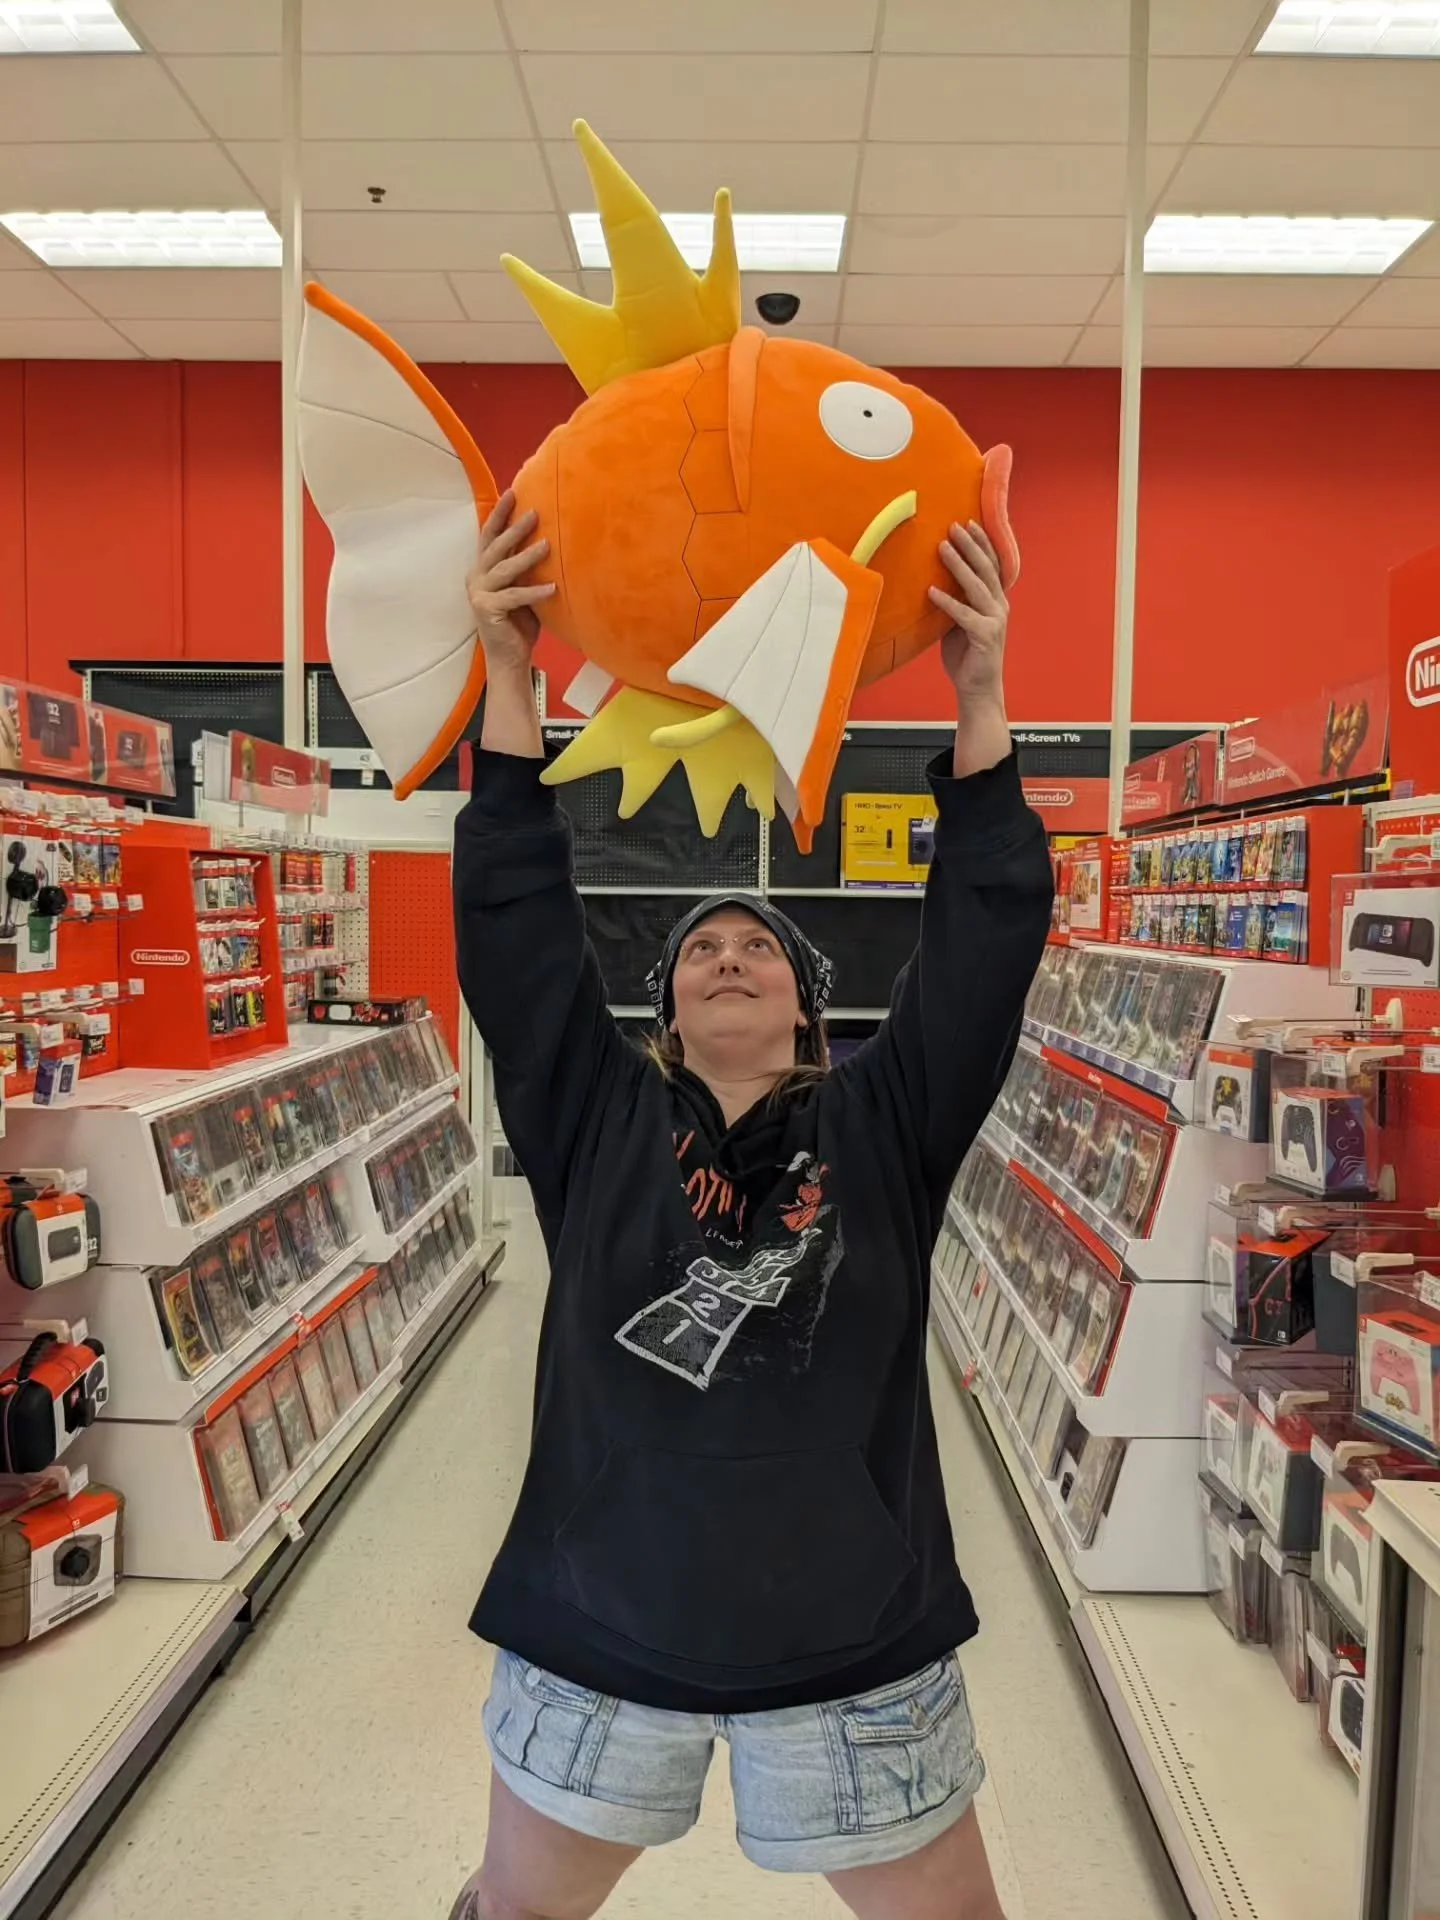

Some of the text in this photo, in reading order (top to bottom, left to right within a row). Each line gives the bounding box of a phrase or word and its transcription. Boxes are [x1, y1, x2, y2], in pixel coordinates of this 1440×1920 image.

[1011, 733, 1081, 743] all-Screen TVs
[136, 953, 185, 962] Nintendo
[692, 1292, 721, 1319] 2
[662, 1318, 692, 1345] 1
